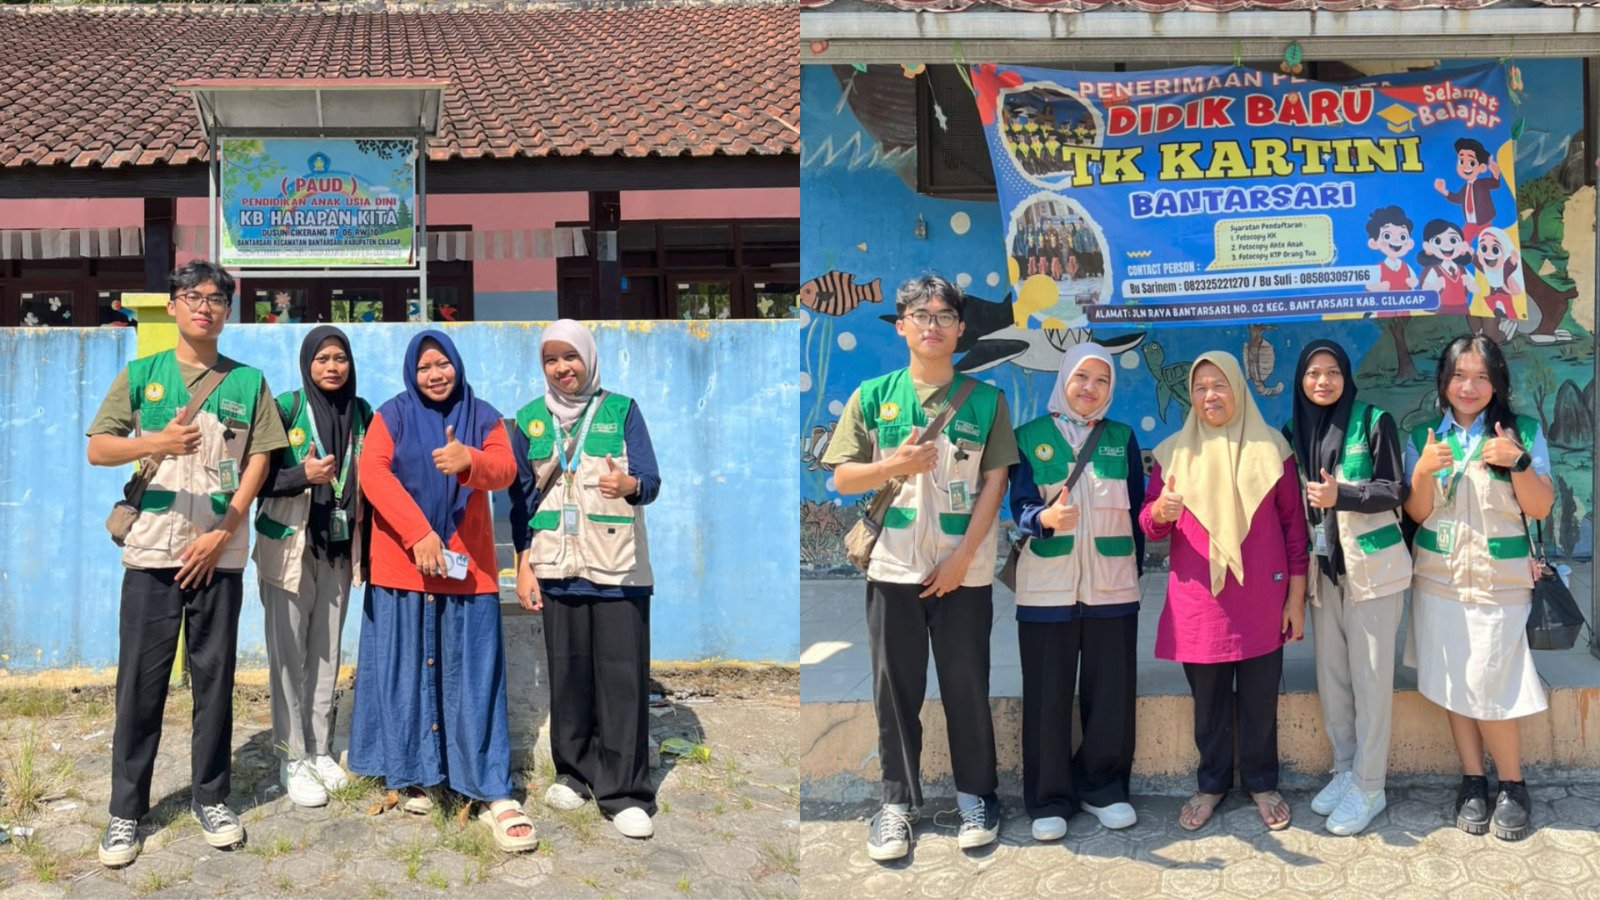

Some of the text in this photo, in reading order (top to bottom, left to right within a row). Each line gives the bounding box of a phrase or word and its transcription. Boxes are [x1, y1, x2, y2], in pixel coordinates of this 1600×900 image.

[1078, 72, 1262, 98] PENERIMAAN
[1422, 81, 1498, 112] Selamat
[1107, 88, 1374, 136] DIDIK BARU
[1418, 102, 1500, 130] Belajar
[1062, 136, 1424, 187] TK KARTINI
[295, 178, 343, 192] PAUD
[242, 198, 397, 207] PENDIDIKAN ANAK USIA DINI
[1130, 182, 1356, 219] BANTARSARI
[240, 209, 398, 227] KB HARAPAN KITA
[1231, 224, 1260, 233] Syaratan
[262, 229, 379, 237] DUSUN CIKERANG RT 06 RW 10
[1128, 263, 1161, 276] CONTACT
[1164, 261, 1194, 274] PERSON
[1130, 282, 1141, 294] Bu
[1142, 281, 1177, 294] Sarinem
[1184, 276, 1250, 291] 082325221270
[1260, 276, 1271, 287] Bu
[1300, 270, 1370, 284] 085803097166
[1095, 295, 1426, 318] ALAMAT: JLN RAYA BANTARSARI NO. 02 KEC. BANTARSARI KAB. CILACAP
